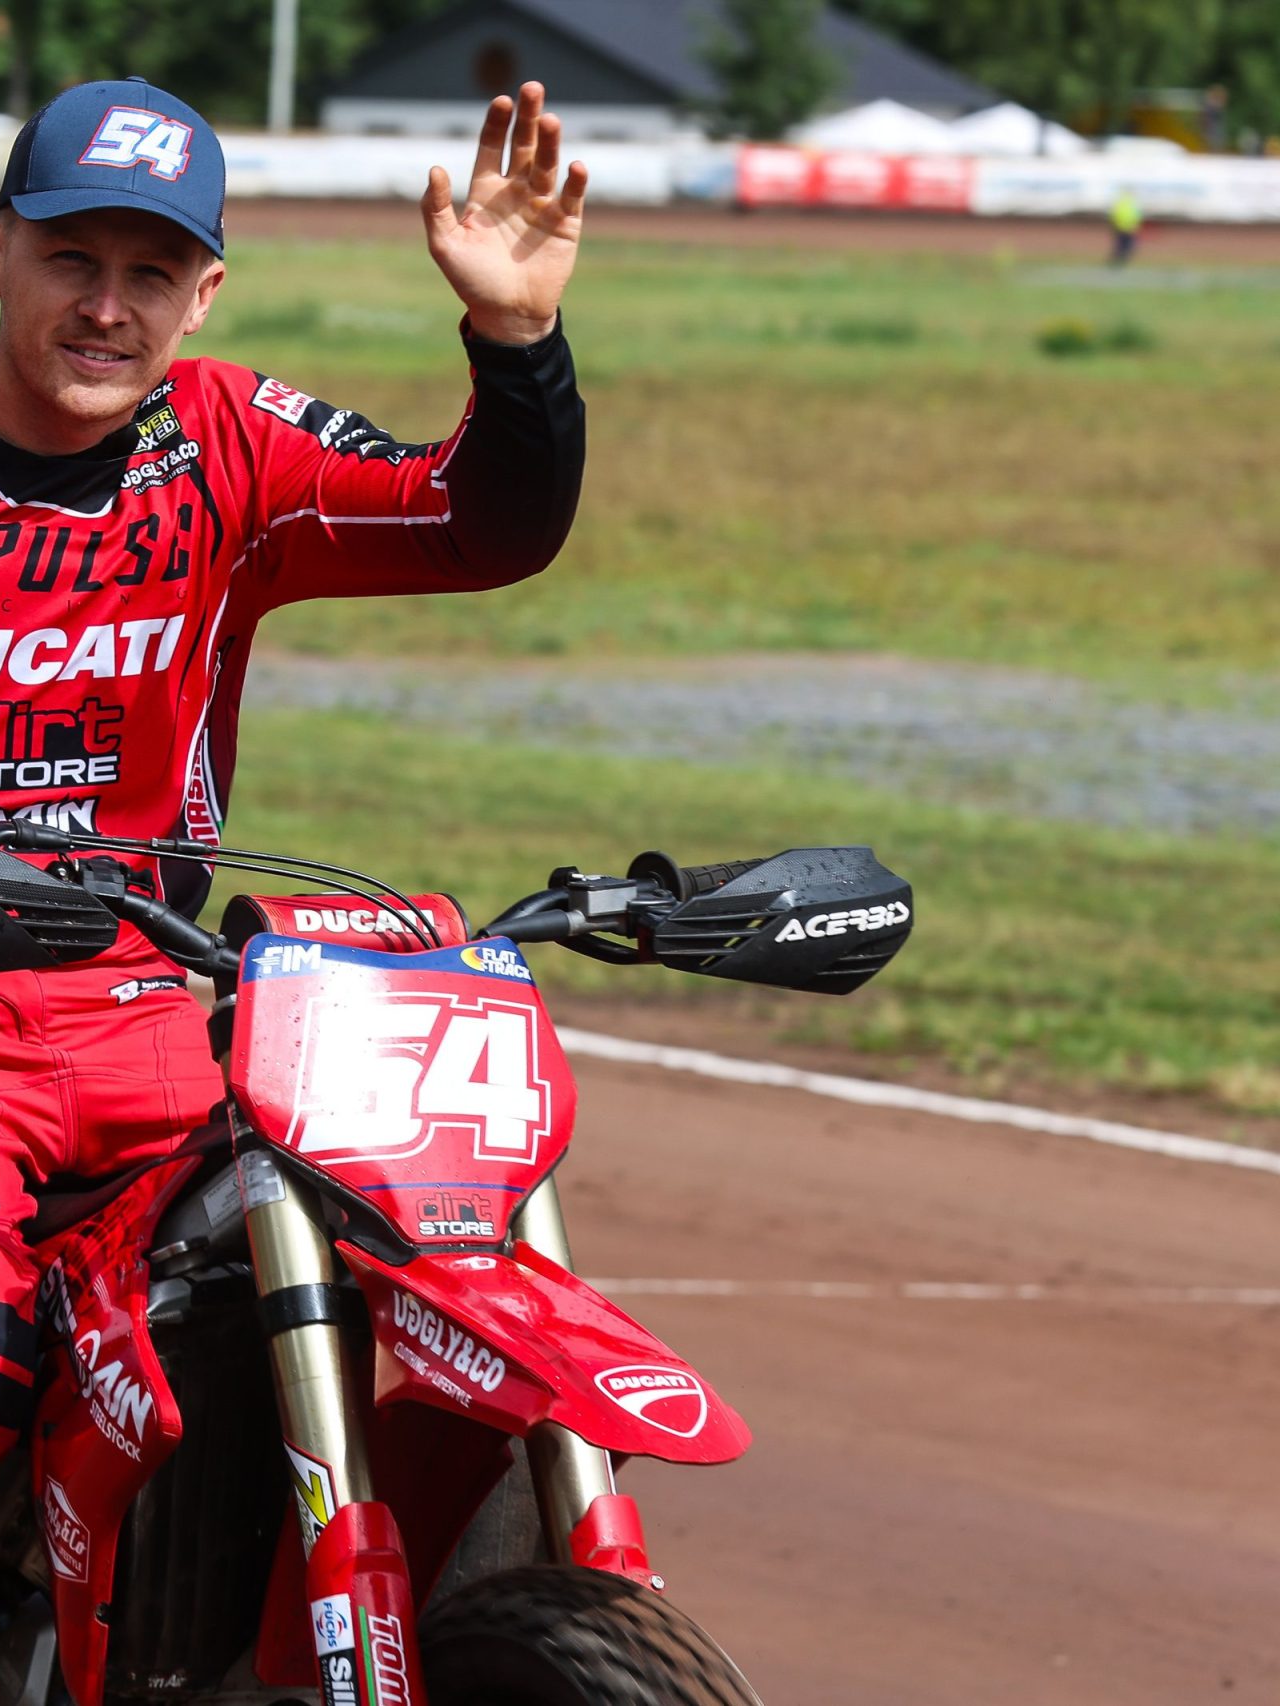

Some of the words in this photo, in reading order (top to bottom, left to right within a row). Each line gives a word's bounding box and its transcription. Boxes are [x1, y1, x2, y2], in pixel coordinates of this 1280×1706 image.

[83, 109, 190, 178] 54
[260, 380, 298, 411] NG
[135, 420, 176, 450] AXED
[137, 410, 171, 437] WER
[293, 908, 435, 935] DUCATI
[773, 900, 910, 943] ACERBIS
[251, 943, 323, 974] FIM
[482, 947, 517, 965] FLAT
[293, 998, 545, 1158] 54
[416, 1192, 496, 1222] dirt
[418, 1220, 496, 1237] STORE
[607, 1375, 689, 1391] DUCATI
[89, 1398, 142, 1463] STEELSTOCK
[322, 1601, 338, 1648] FUCHS
